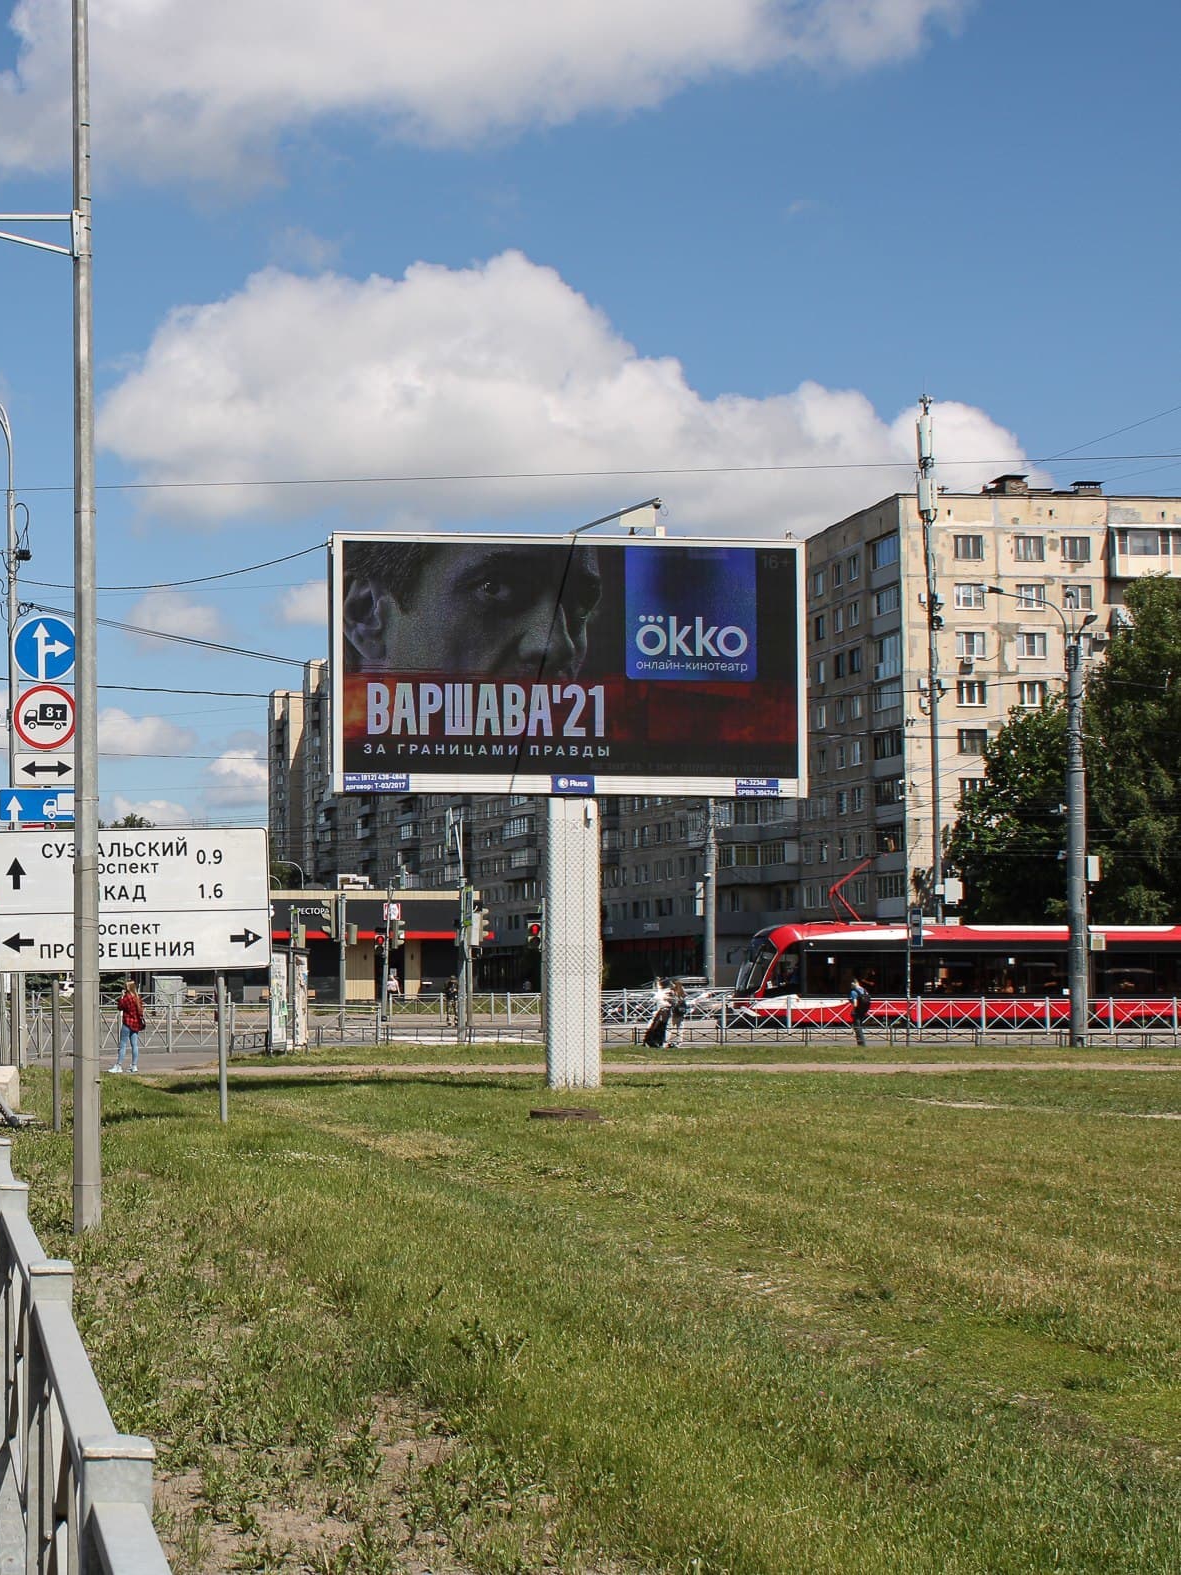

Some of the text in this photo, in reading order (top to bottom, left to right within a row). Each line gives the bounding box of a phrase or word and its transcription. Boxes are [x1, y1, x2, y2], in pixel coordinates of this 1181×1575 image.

[635, 659, 749, 673] онлайн-кинотеатр
[366, 683, 605, 737] ВАРШАВА'21
[363, 743, 610, 758] ЗА ГРАНИЦАМИ ПРАВДЫ
[570, 779, 588, 787] Russ
[41, 837, 223, 865] СУЗАЛЬСКИЙ 0.9
[198, 883, 224, 899] 1.6
[39, 941, 195, 961] ПРОВЕЩЕНИЯ
